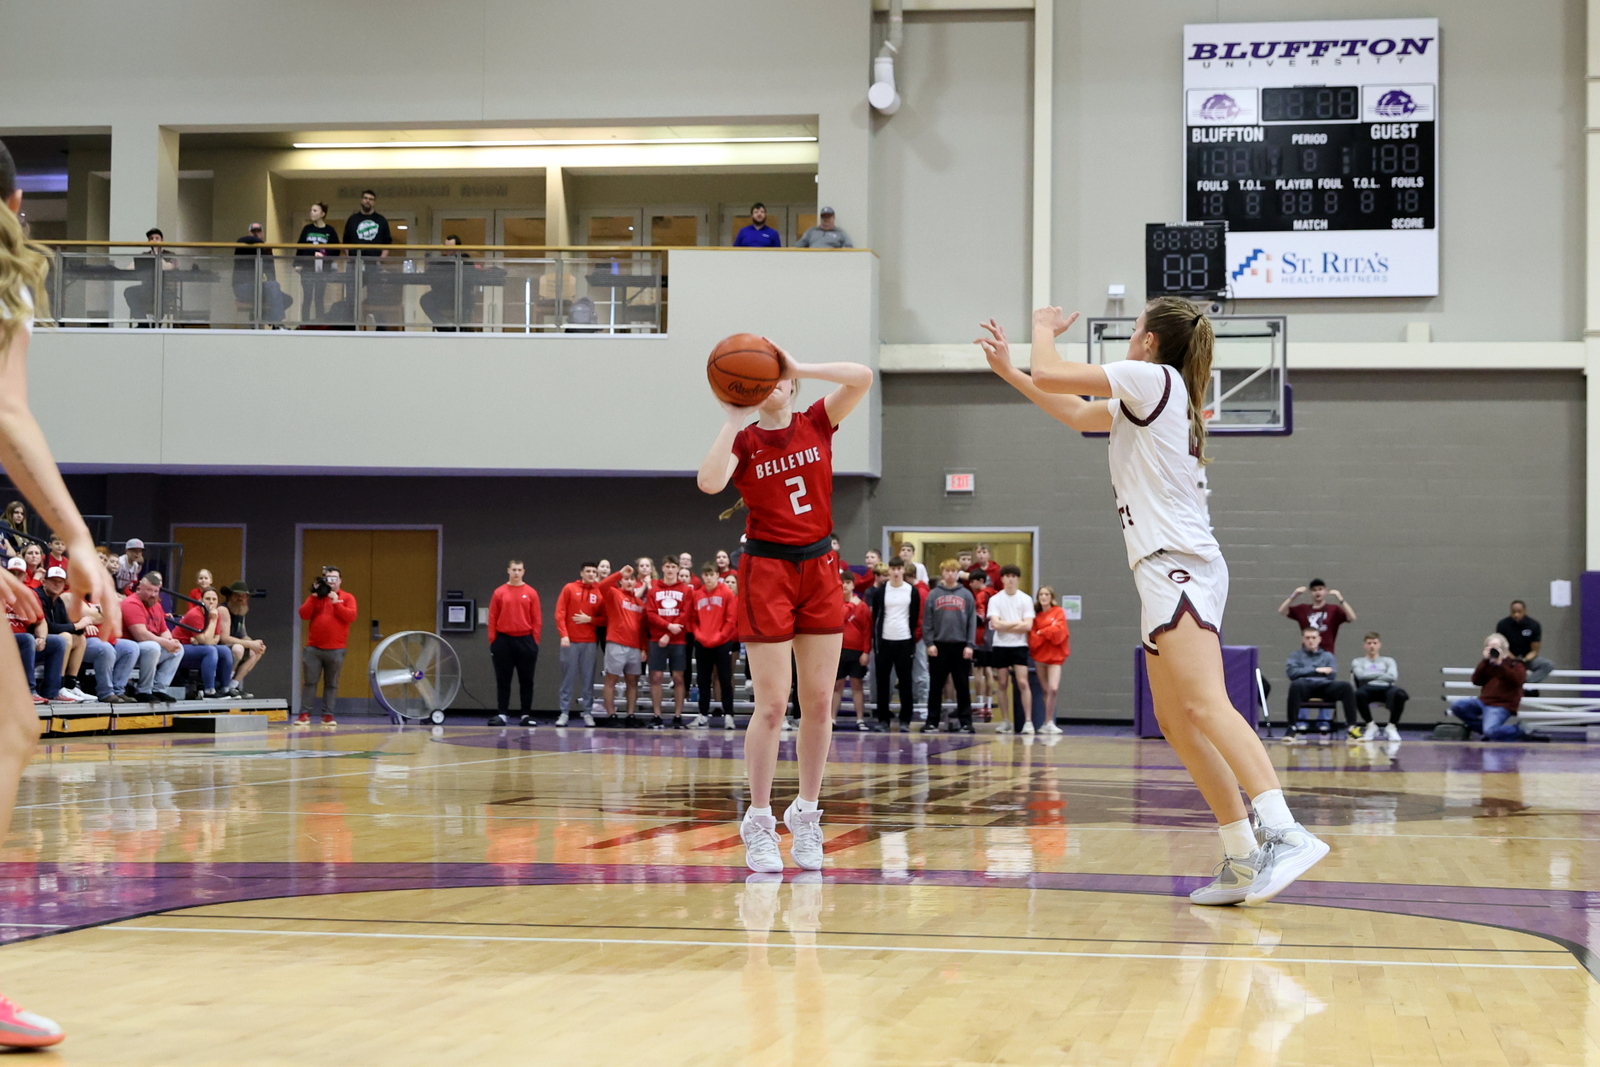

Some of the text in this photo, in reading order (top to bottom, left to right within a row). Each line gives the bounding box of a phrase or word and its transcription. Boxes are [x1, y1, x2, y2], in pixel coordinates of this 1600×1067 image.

[1188, 38, 1435, 60] BLUFFTON
[1203, 57, 1404, 68] UNIVERSITY
[1192, 127, 1264, 143] BLUFFTON
[1370, 123, 1419, 140] GUEST
[1291, 133, 1328, 145] PERIOD
[1197, 180, 1229, 191] FOULS
[1275, 178, 1344, 190] PLAYER FOUL
[1391, 176, 1424, 188] FOULS
[1293, 219, 1328, 230] MATCH
[1391, 217, 1425, 229] SCORE
[1281, 275, 1388, 284] HEALTH PARTNERS
[755, 446, 821, 480] BELLEVUE
[951, 474, 970, 489] EXIT
[784, 475, 812, 516] 2
